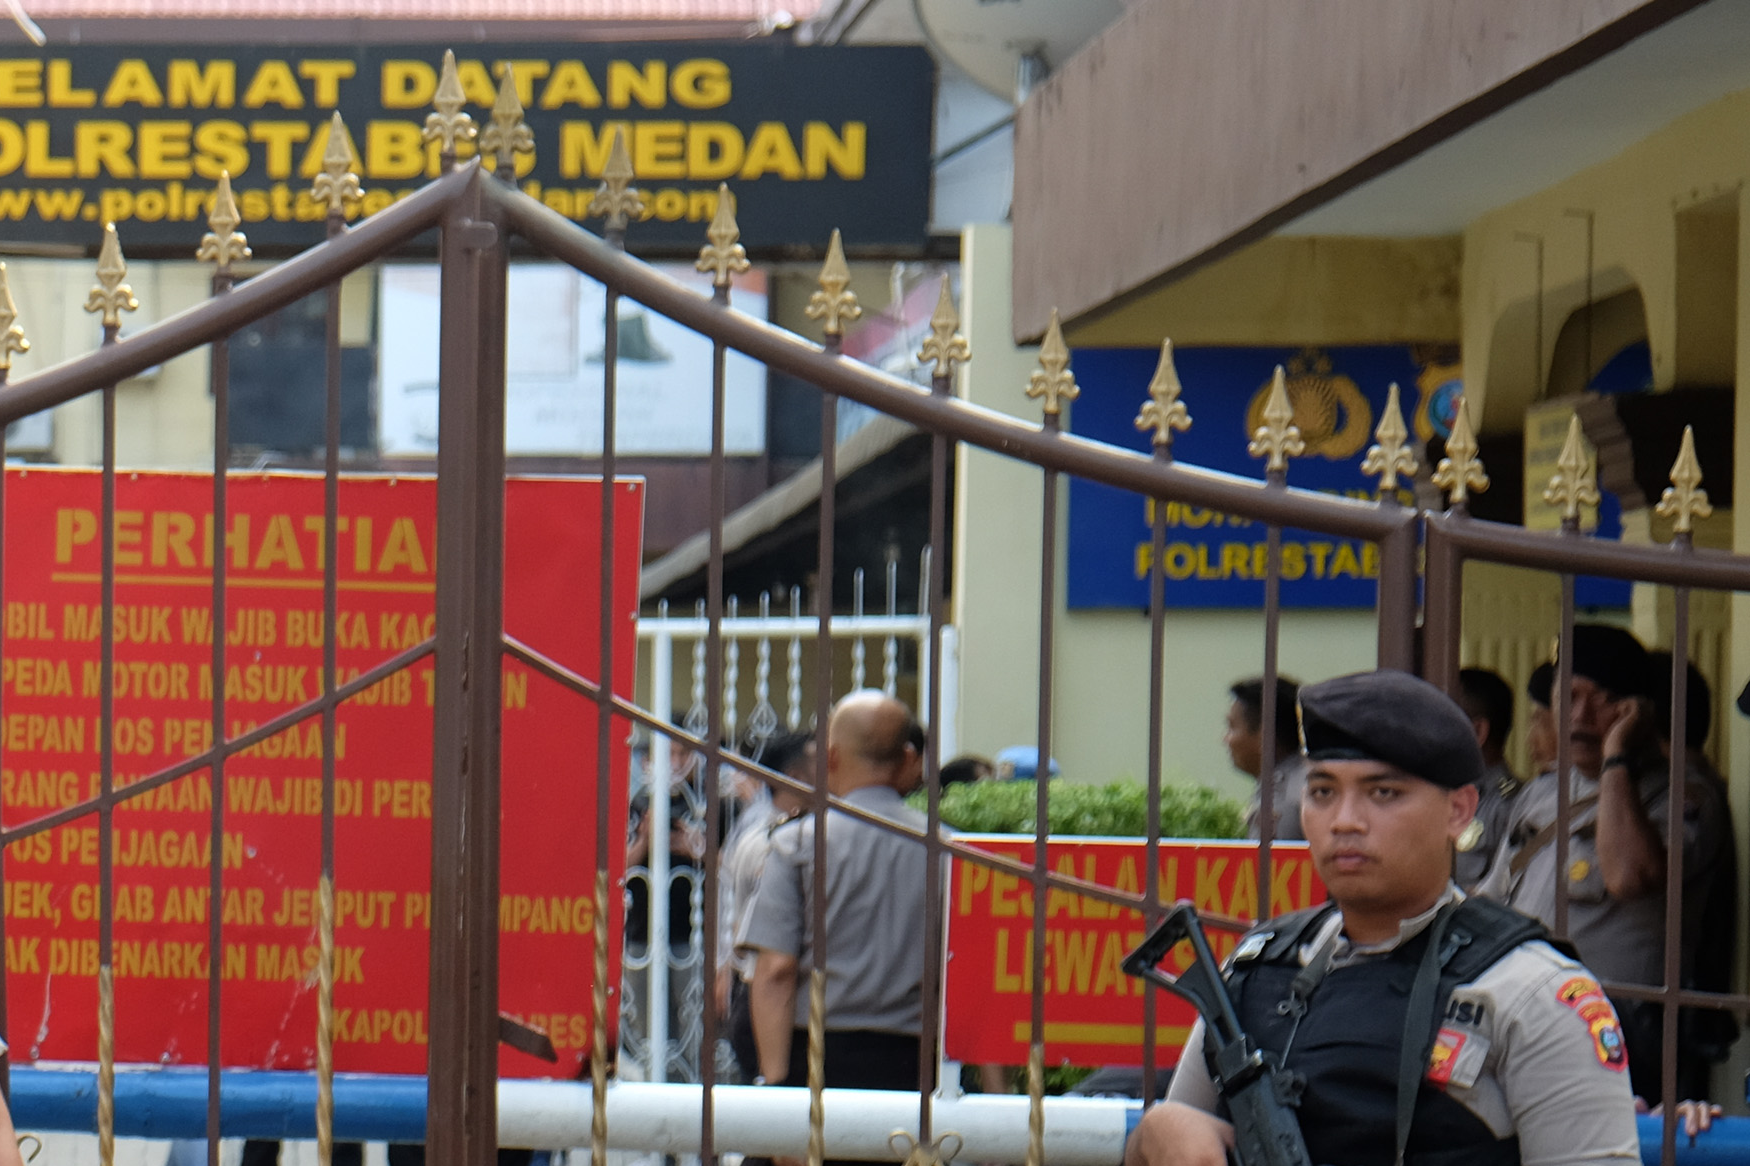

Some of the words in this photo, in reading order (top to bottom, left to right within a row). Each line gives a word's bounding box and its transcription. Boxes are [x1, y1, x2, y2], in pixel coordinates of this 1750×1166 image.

[380, 58, 732, 109] DATANG
[558, 121, 867, 179] MEDAN
[56, 508, 438, 574] PERHATIA
[181, 606, 277, 647] WJIB
[228, 776, 324, 815] WAJIB
[333, 778, 364, 817] DI
[162, 885, 265, 926] ANAR
[1194, 855, 1314, 921] KAKI
[50, 937, 247, 980] DIBNARKN
